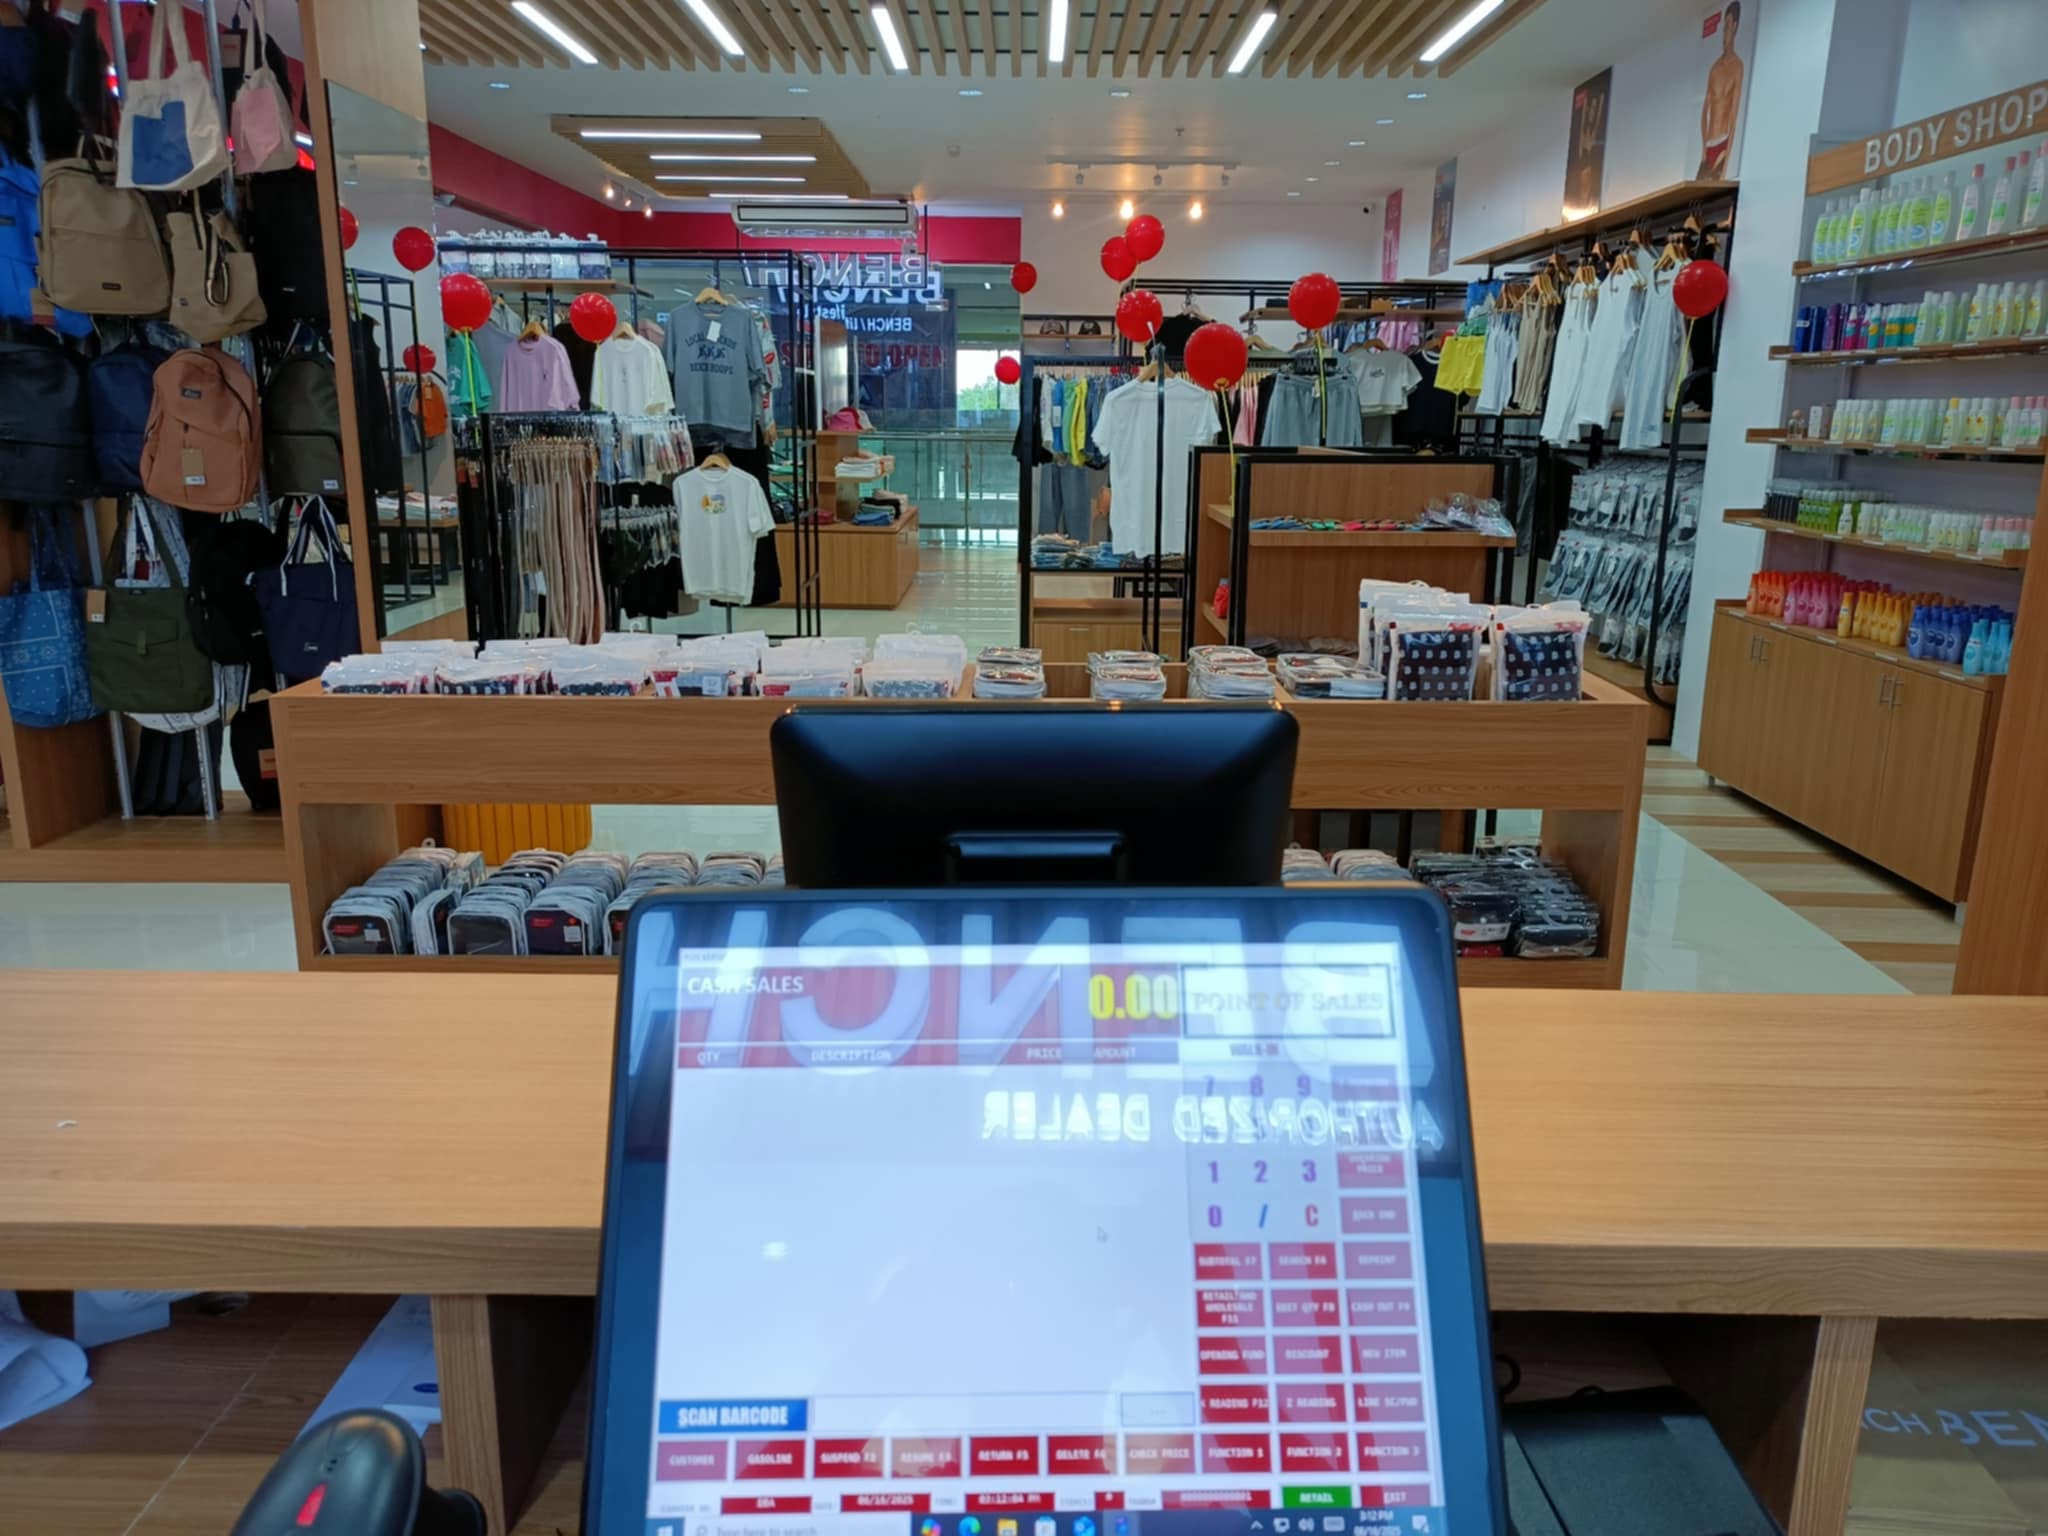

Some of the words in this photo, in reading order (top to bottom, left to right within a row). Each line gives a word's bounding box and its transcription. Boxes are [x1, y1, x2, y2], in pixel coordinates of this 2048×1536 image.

[1864, 119, 1945, 174] BODY
[1954, 88, 2048, 148] SHOP
[748, 975, 804, 994] SALES
[1088, 973, 1178, 1020] 0.00
[1192, 991, 1269, 1011] POINT
[1274, 991, 1304, 1010] OF
[1311, 990, 1385, 1011] SALES
[697, 1051, 720, 1066] QTY
[810, 1048, 892, 1063] DESCRIPTION
[1026, 1046, 1063, 1060] PRICE
[1208, 1160, 1219, 1183] 1
[1255, 1160, 1268, 1183] 2
[1302, 1159, 1317, 1182] 3
[1208, 1204, 1222, 1228] 0
[1305, 1204, 1319, 1227] C
[677, 1407, 719, 1428] SCAN
[720, 1405, 789, 1426] BARCODE
[1861, 1407, 1933, 1435] CH
[747, 1452, 793, 1465] GASOLINE
[978, 1449, 1013, 1462] RETURN
[1055, 1448, 1090, 1460] DELETE
[1299, 1492, 1334, 1504] RETAIL
[1378, 1510, 1394, 1521] PM
